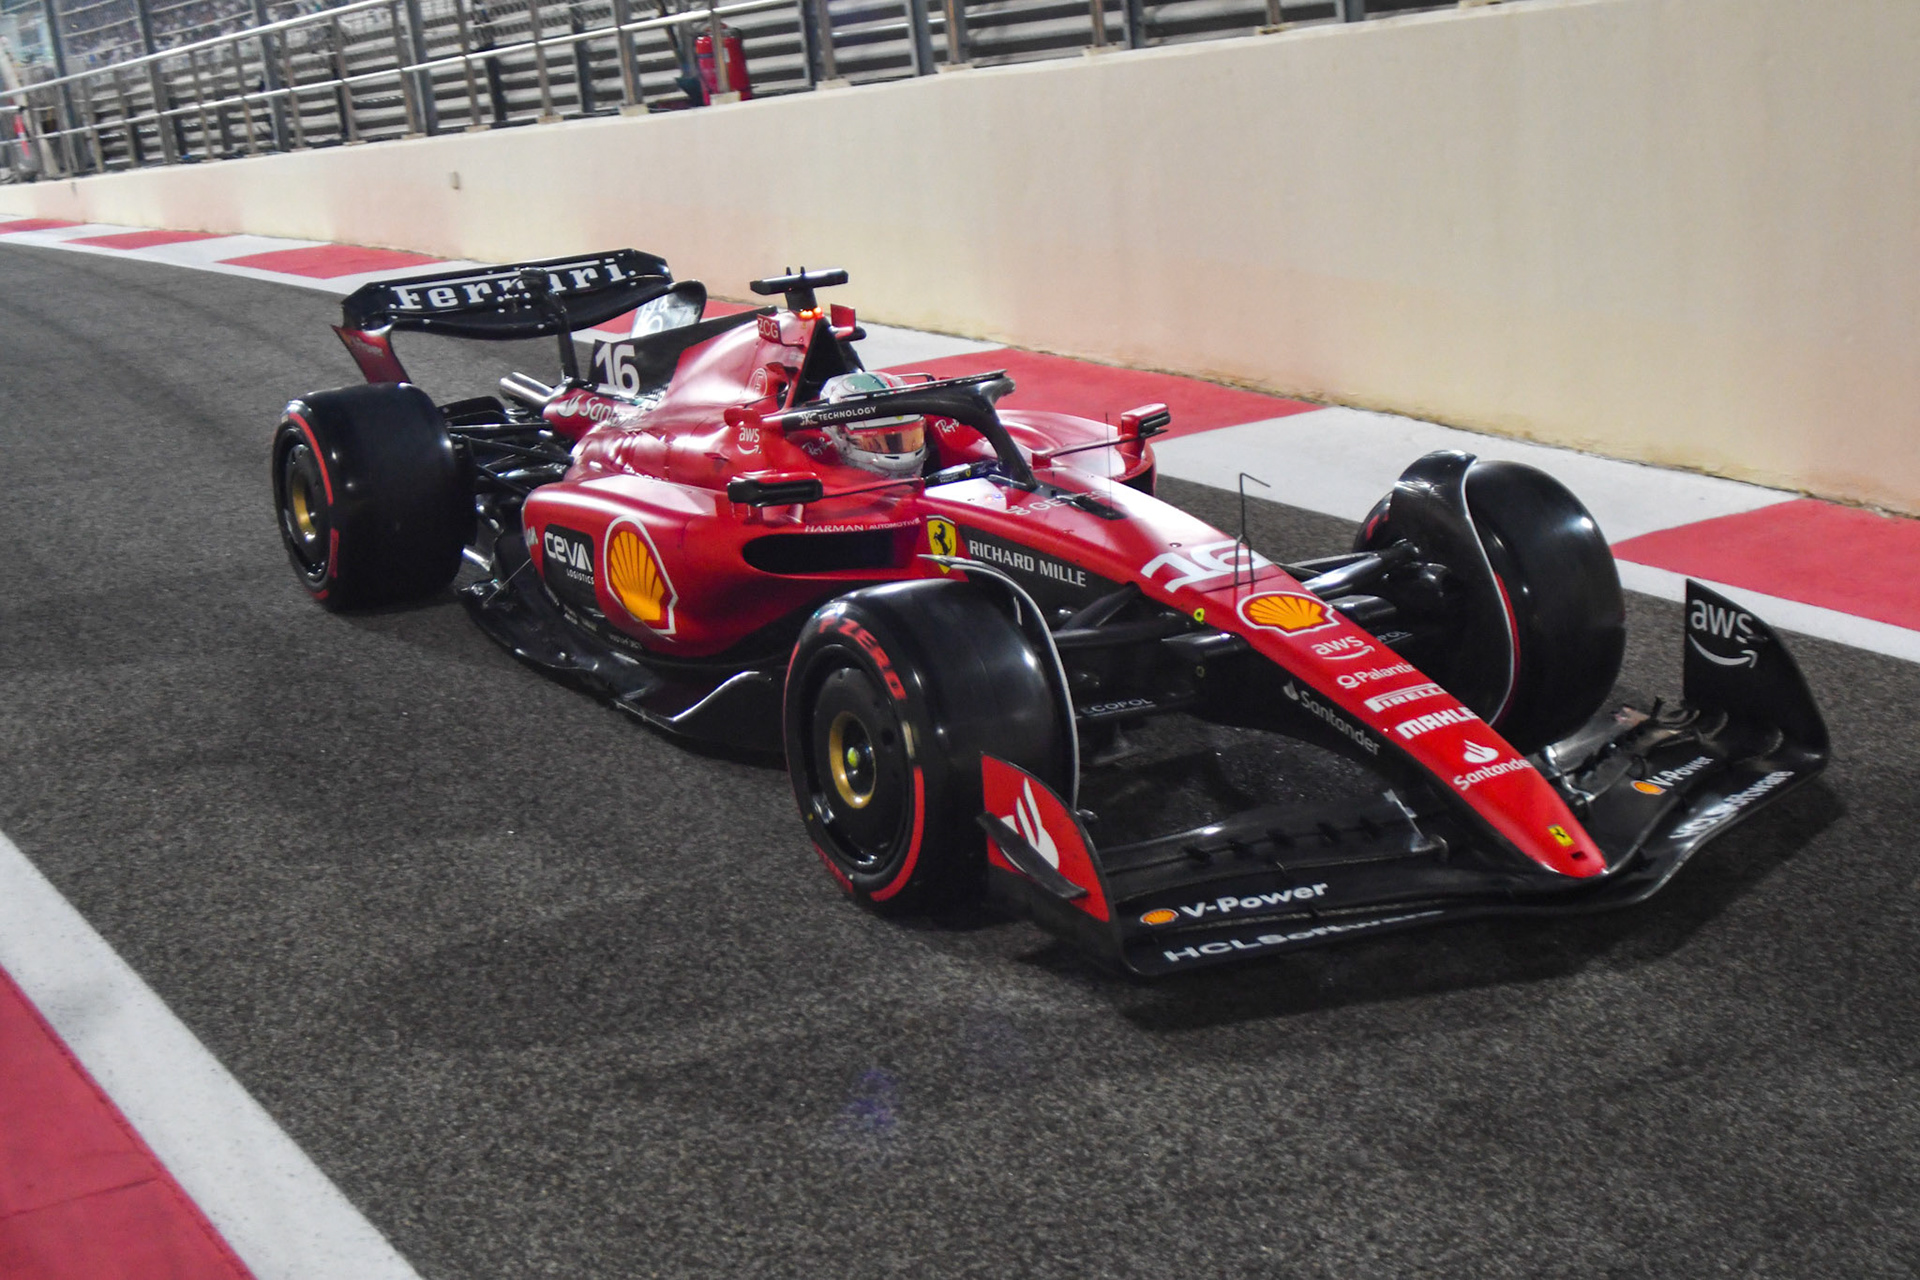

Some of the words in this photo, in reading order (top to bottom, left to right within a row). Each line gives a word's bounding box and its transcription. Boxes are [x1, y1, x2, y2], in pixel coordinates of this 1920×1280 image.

[595, 342, 640, 398] 16
[818, 406, 877, 421] TECHNOLOGY
[738, 426, 761, 444] aws
[804, 524, 864, 533] HARMAN
[566, 568, 595, 585] LOGISTICS
[969, 540, 1035, 573] RICHARD
[1039, 559, 1087, 588] MILLE
[1140, 538, 1275, 594] 16
[1691, 598, 1755, 644] aws
[1310, 635, 1365, 656] aws
[1300, 689, 1381, 757] Santander
[1394, 706, 1481, 740] MAHLE
[1453, 757, 1534, 792] Santande
[1645, 755, 1715, 787] V-Power
[1179, 880, 1329, 920] V-Power
